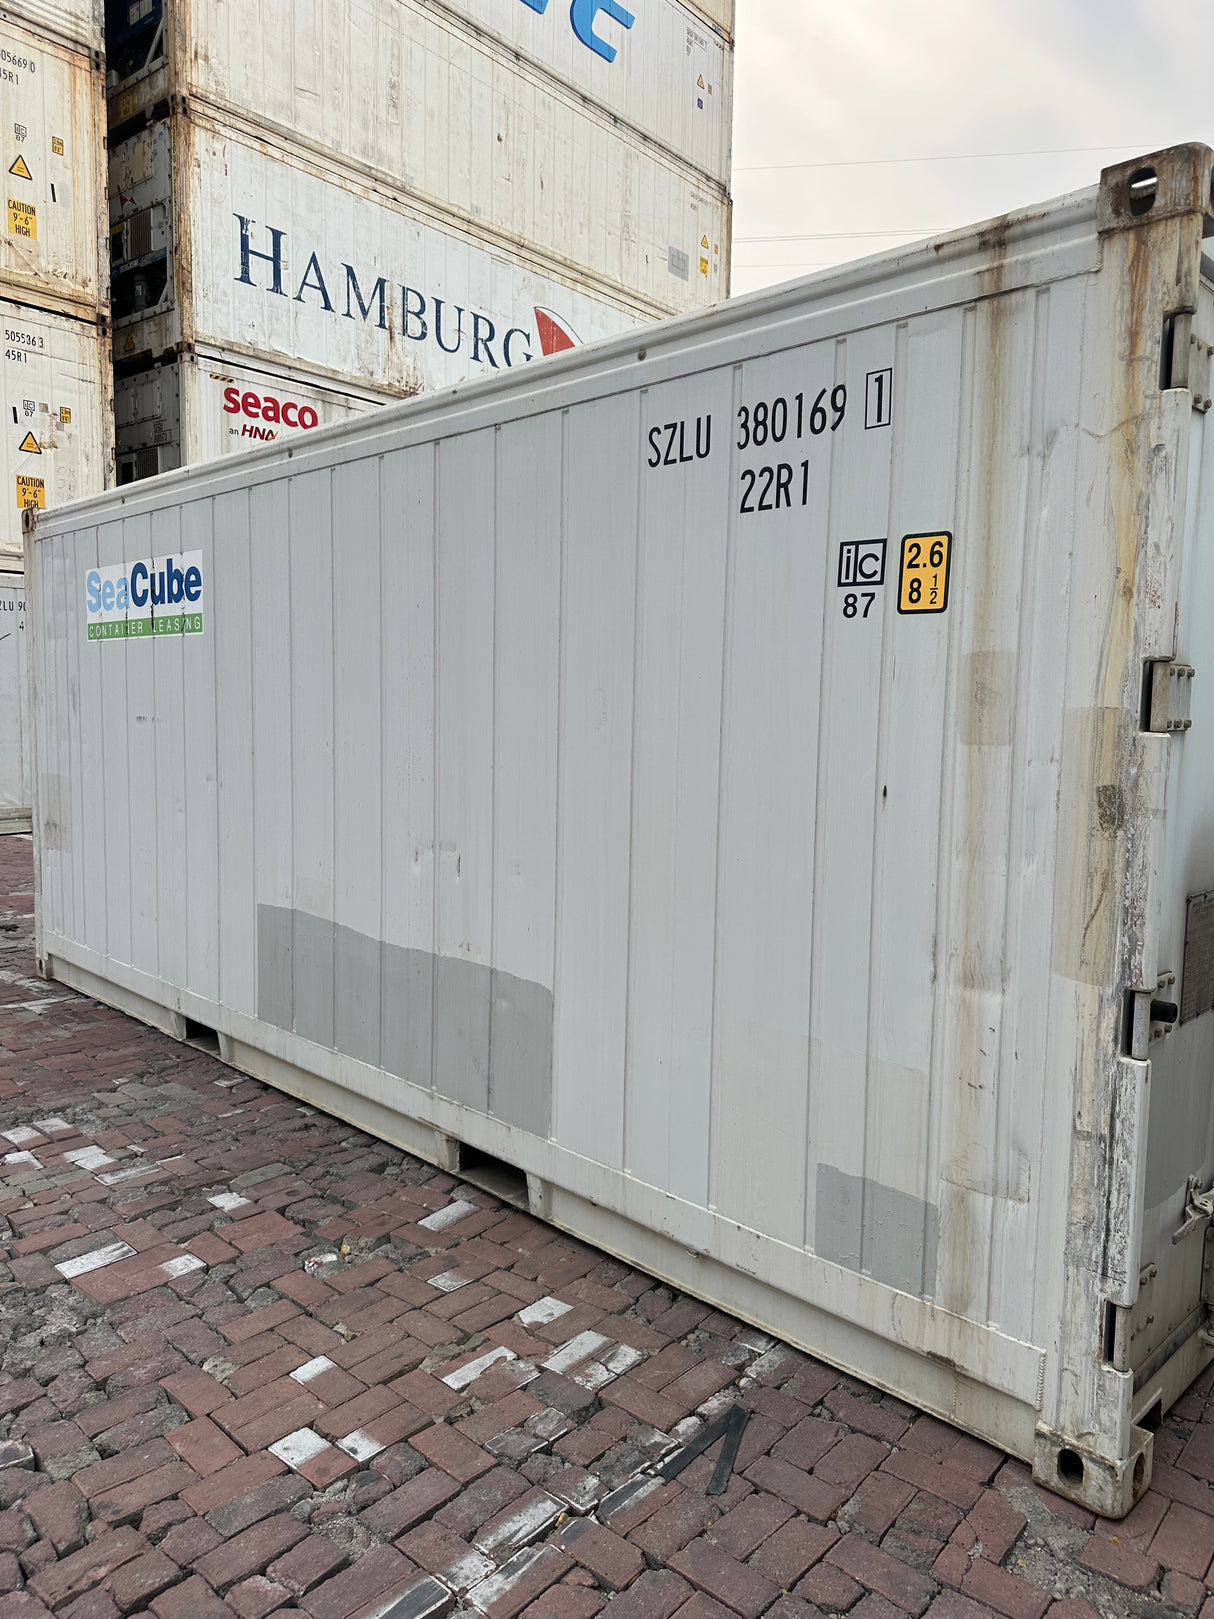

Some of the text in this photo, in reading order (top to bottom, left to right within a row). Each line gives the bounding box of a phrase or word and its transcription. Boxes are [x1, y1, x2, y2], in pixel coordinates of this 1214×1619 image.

[0, 68, 19, 85] 5R1
[8, 199, 36, 216] CAUTION
[15, 224, 30, 237] HIGH
[233, 212, 534, 369] HAMBURG
[5, 349, 27, 363] 45R1
[223, 387, 319, 430] seaco
[229, 427, 239, 436] an
[647, 414, 712, 467] SZLU
[736, 384, 847, 450] 380169
[16, 475, 45, 489] CAUTION
[739, 459, 809, 513] 22R1
[23, 499, 39, 509] HIGH
[906, 540, 945, 570] 2.6
[86, 557, 202, 613] SeaCube
[842, 592, 876, 618] 87
